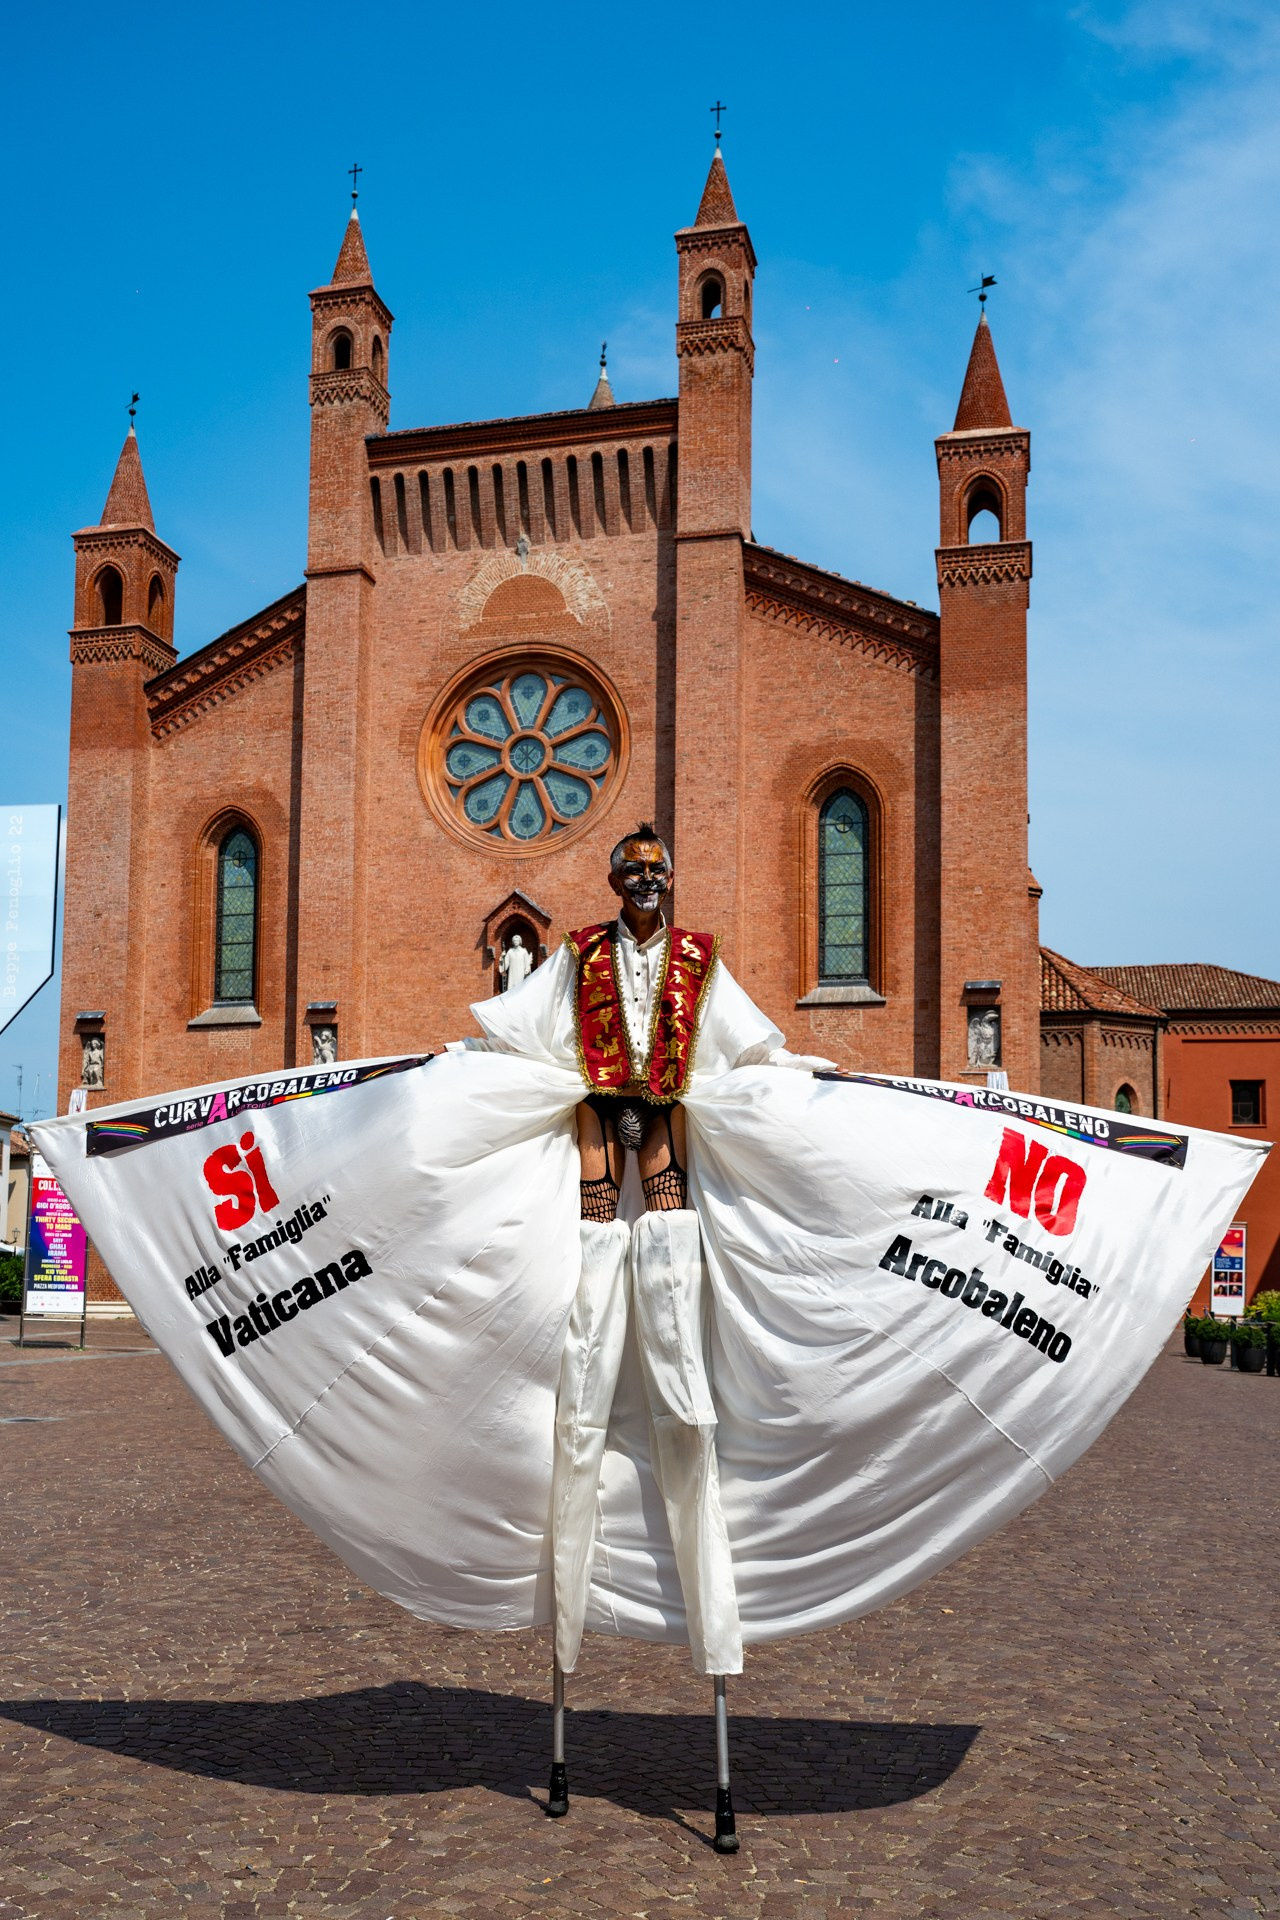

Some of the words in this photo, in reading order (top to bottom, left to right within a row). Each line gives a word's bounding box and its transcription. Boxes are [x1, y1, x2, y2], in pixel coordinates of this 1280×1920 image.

[8, 815, 23, 835] 22
[6, 844, 23, 931] Fenoglio
[3, 942, 20, 997] Beppe
[154, 1070, 358, 1128] CURVARCOBALENO
[891, 1081, 1110, 1138] CURVARCOBALENO
[983, 1126, 1087, 1237] NO
[184, 1264, 221, 1300] Alla
[223, 1195, 331, 1269] "Famiglia"
[911, 1194, 969, 1230] Alla
[982, 1219, 1100, 1299] "Famiglia"
[206, 1248, 373, 1358] Vaticana
[878, 1234, 1072, 1364] Arcobaleno
